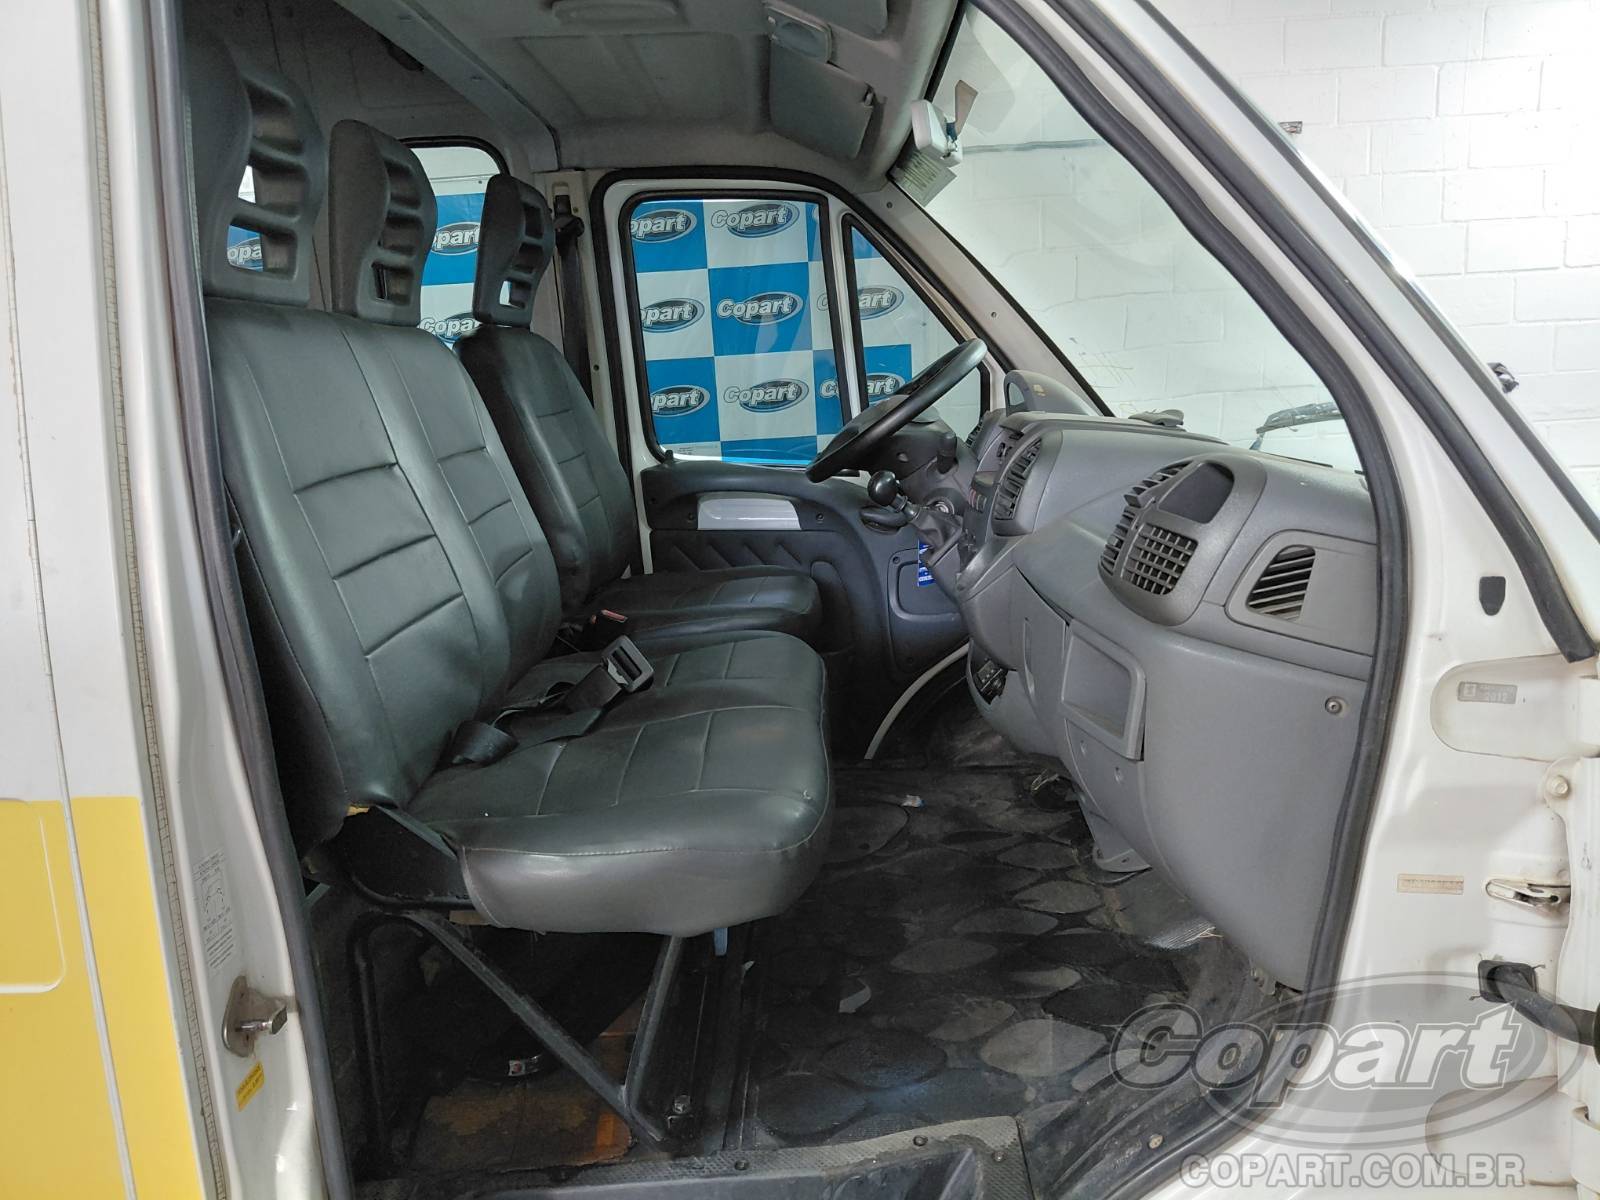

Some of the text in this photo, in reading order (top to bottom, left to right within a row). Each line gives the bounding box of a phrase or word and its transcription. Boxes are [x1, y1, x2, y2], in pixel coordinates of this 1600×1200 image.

[631, 212, 687, 239] opart
[711, 202, 792, 232] Copart
[432, 226, 480, 251] part
[227, 244, 262, 265] opa
[717, 293, 794, 321] Copart
[418, 317, 480, 339] Copa
[651, 389, 700, 413] part
[723, 381, 802, 409] Copart
